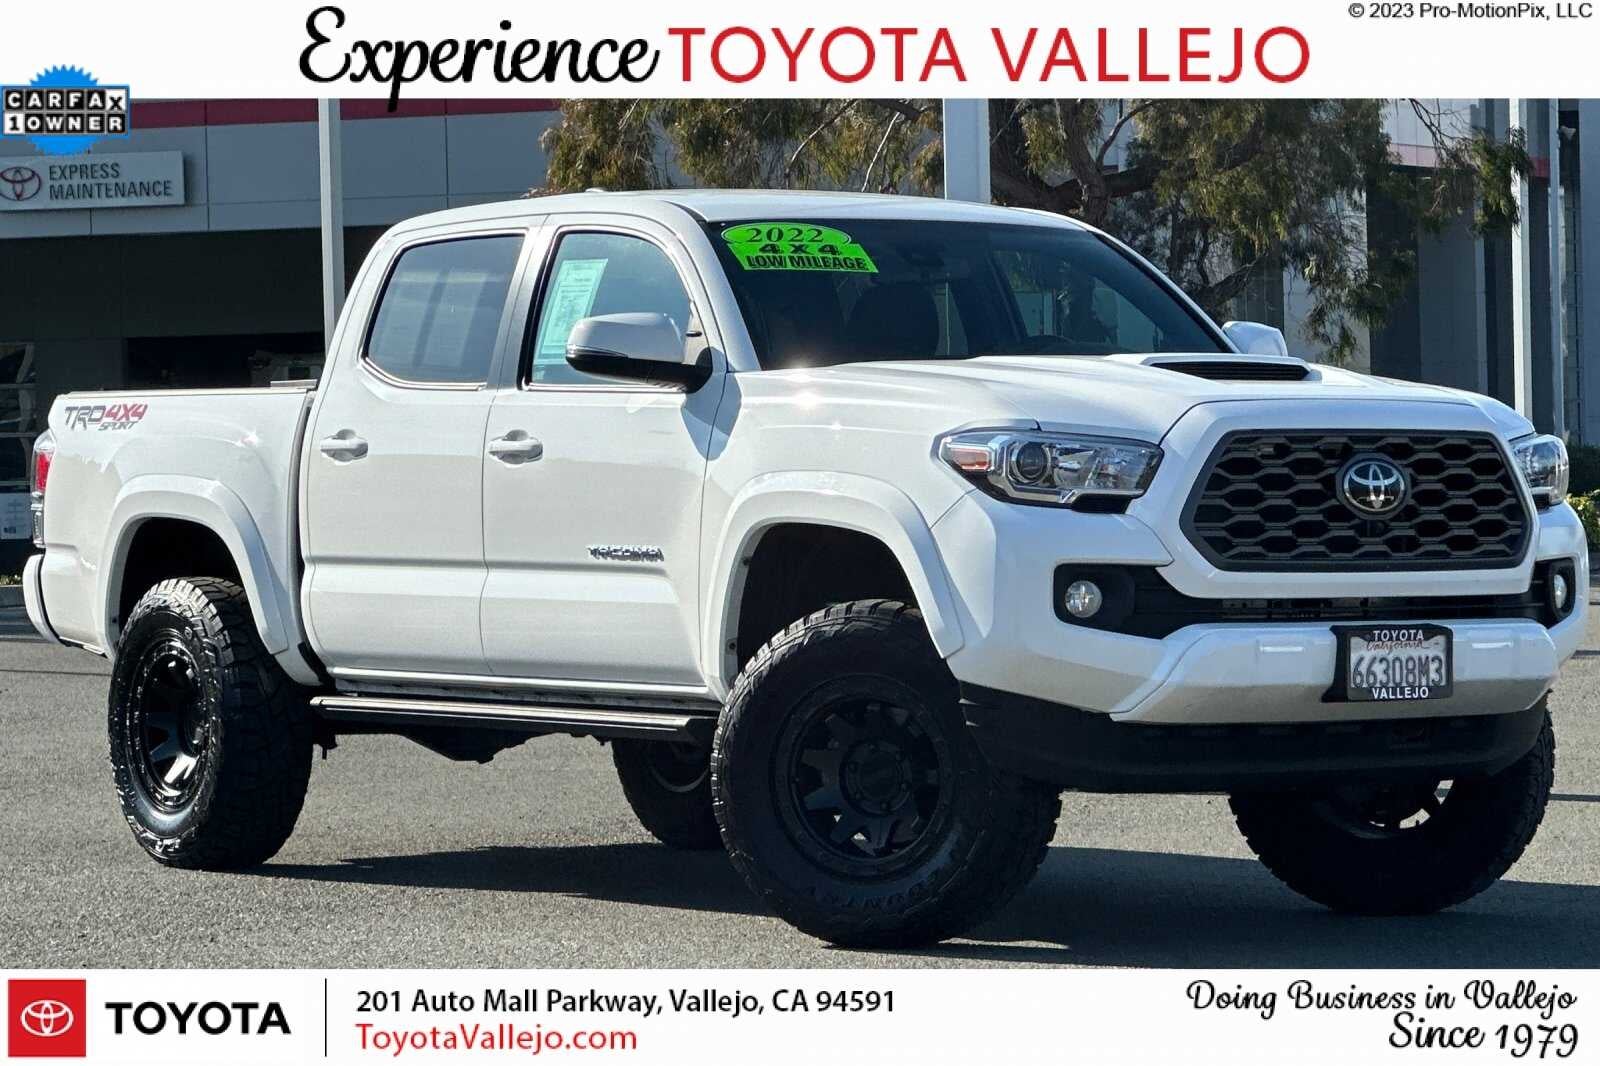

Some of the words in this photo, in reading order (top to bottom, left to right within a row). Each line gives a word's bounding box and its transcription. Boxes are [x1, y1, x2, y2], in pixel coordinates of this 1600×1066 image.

[49, 162, 121, 181] EXPRESS
[49, 179, 174, 200] MAINTENANCE
[746, 227, 824, 243] 2022
[746, 255, 786, 269] LOW
[789, 256, 868, 271] MILEAGE
[98, 420, 140, 431] SPORT
[1372, 629, 1425, 641] TOYOTA
[1352, 654, 1444, 688] 66308M3
[1372, 687, 1430, 700] VALLEJO
